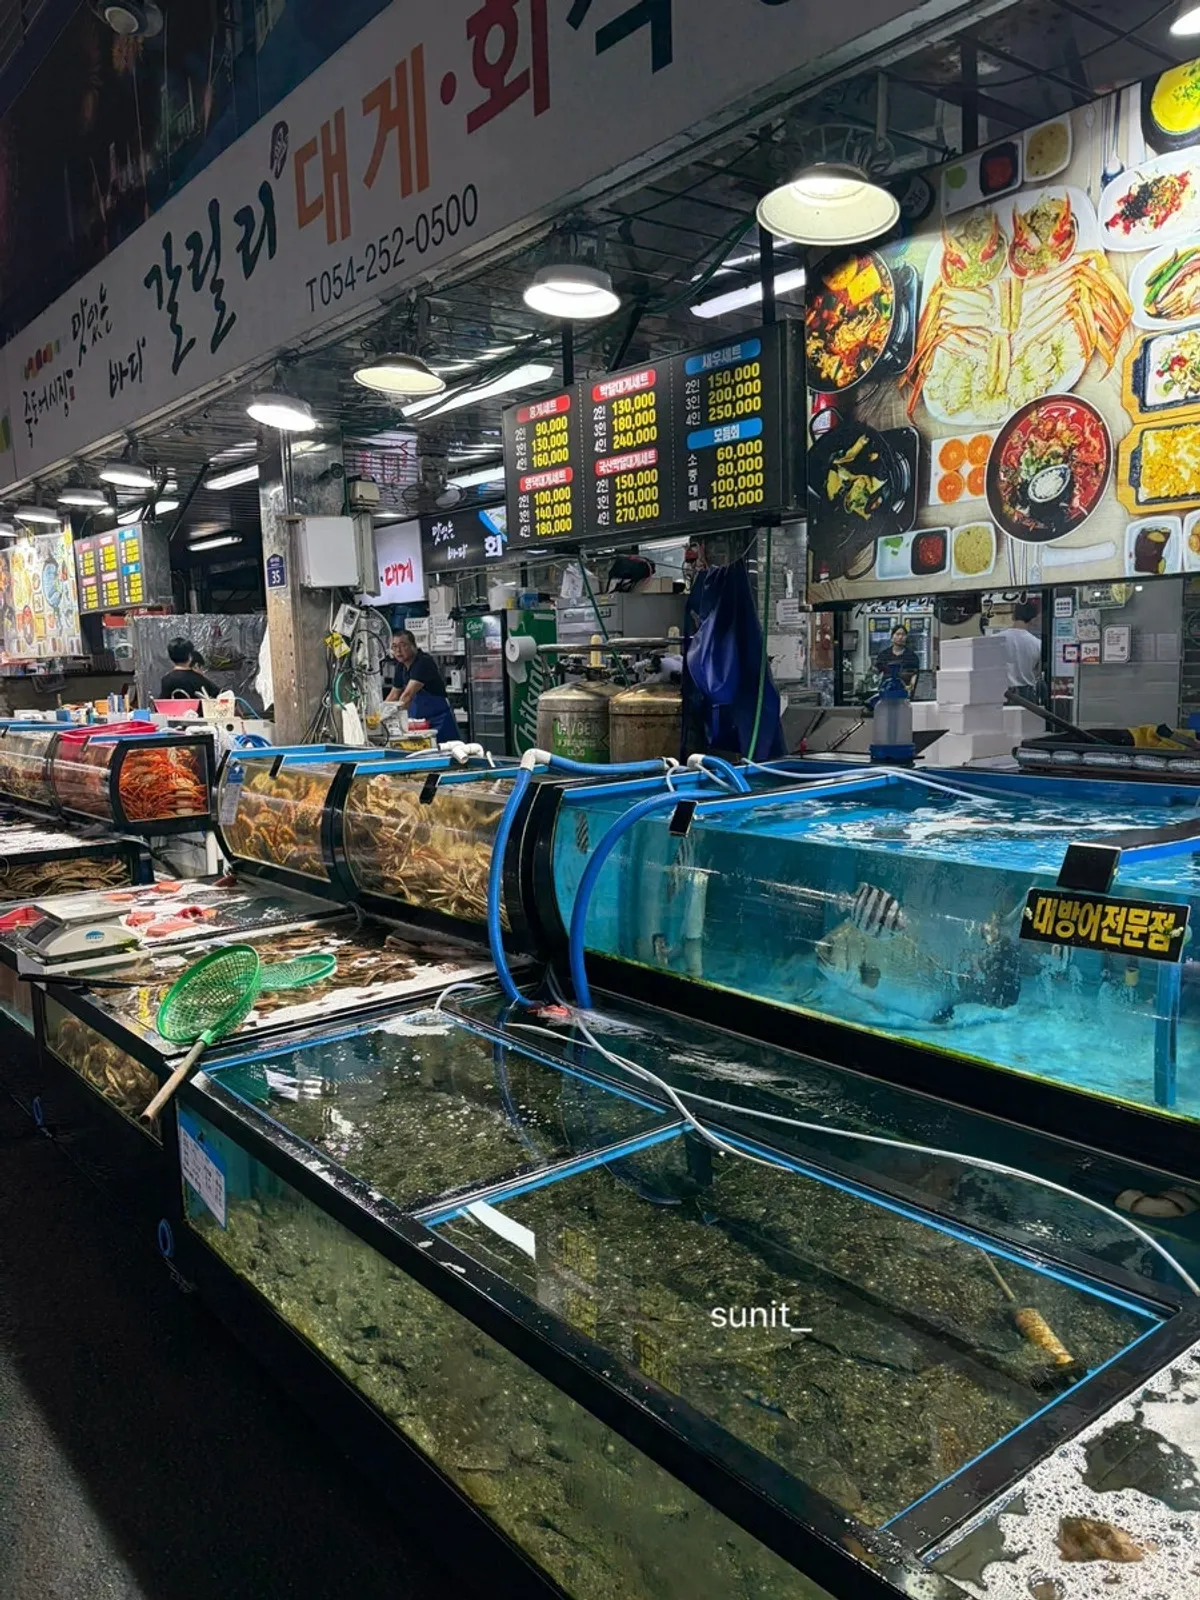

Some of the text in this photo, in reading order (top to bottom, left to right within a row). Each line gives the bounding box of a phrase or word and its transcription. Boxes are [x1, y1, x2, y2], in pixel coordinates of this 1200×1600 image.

[71, 283, 113, 368] 맛있는
[685, 362, 760, 394] 2인 150,000
[593, 391, 656, 420] 2인 130,000
[686, 379, 762, 411] 3인 200,000
[594, 409, 656, 437] 3인 180,000
[686, 396, 762, 426] 4인 250,000
[515, 416, 568, 441] 2인 90,000
[594, 426, 657, 453] 4인 240,000
[531, 431, 568, 453] 130,000
[688, 439, 763, 466] 소 60,000
[531, 447, 569, 468] 160,000
[688, 456, 763, 483] 중 80,000
[596, 469, 658, 493] 2인 150,000
[688, 472, 764, 497] 대 100,000
[519, 486, 571, 509] 2인 100,000
[597, 486, 659, 509] 3인 210,000
[688, 489, 764, 512] 특대 120,000
[534, 502, 571, 521] 140,000
[597, 503, 660, 526] 4인 270,000
[520, 518, 572, 537] 4인 180,000
[484, 534, 503, 557] 회
[271, 570, 281, 584] 35
[1032, 896, 1177, 953] 대방어전문점
